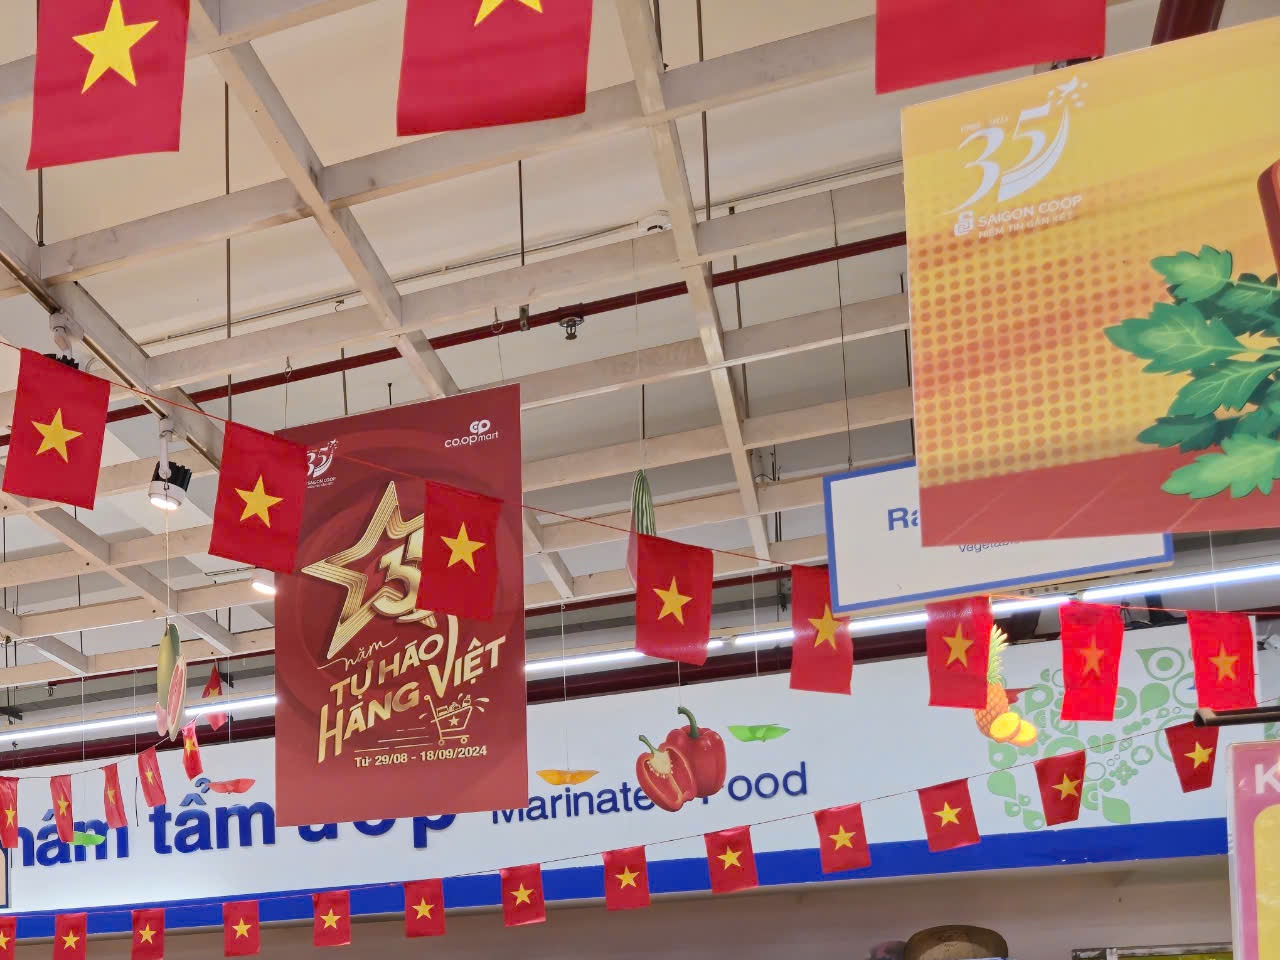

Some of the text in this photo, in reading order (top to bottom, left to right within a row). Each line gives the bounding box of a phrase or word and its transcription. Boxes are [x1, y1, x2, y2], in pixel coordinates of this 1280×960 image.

[944, 103, 1069, 215] 35
[978, 206, 1034, 228] SAIGON
[330, 660, 375, 706] TỰ
[427, 614, 507, 699] VIỆT
[375, 753, 408, 767] 29/08
[420, 745, 488, 761] 18/09/2024
[148, 776, 276, 855] tẩm
[492, 761, 809, 825] arinate ood
